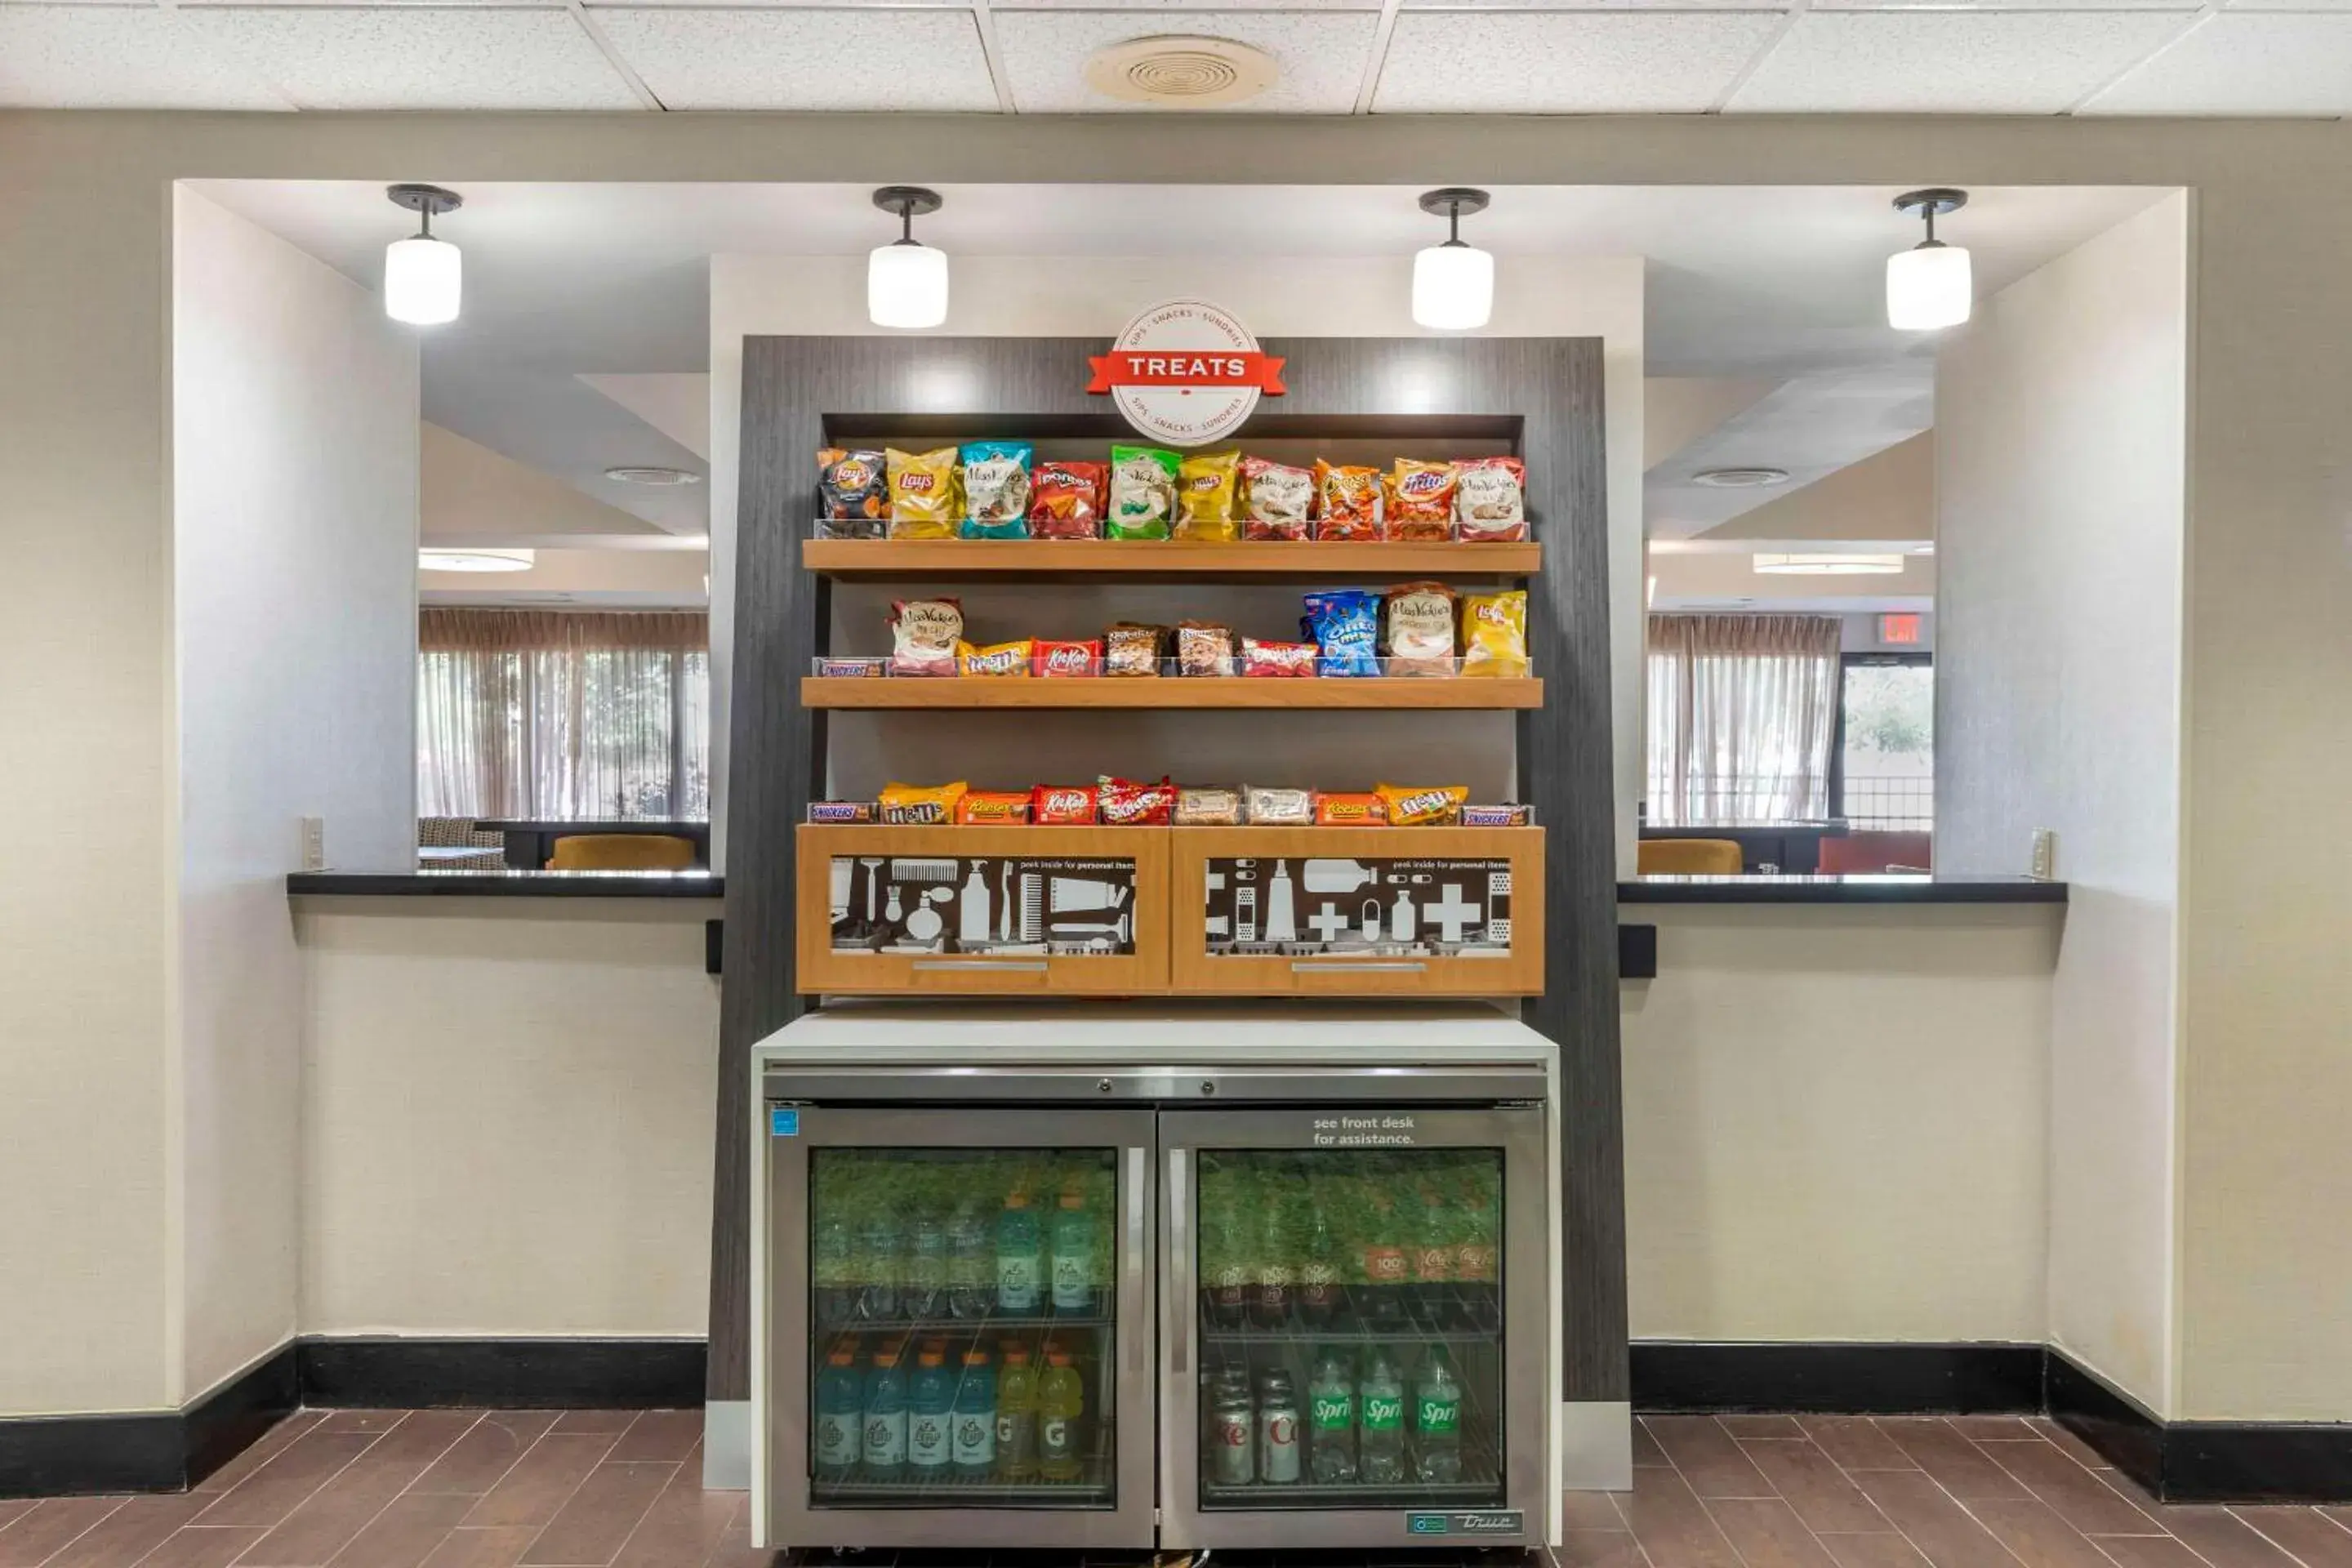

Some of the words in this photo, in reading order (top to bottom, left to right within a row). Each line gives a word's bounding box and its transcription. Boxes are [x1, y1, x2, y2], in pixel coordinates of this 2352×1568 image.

[1129, 327, 1147, 346] SIPS
[1152, 310, 1193, 325] SNACKS
[1202, 312, 1243, 348] SUNDRIES
[1127, 358, 1245, 376] TREATS
[1132, 397, 1148, 416] SIPS
[1153, 415, 1193, 433] SNACKS
[1201, 398, 1242, 430] SUNDRIES
[900, 473, 933, 490] Lay's
[1020, 861, 1039, 869] peek
[1040, 860, 1062, 869] inside
[1064, 860, 1075, 869] for
[1077, 862, 1114, 870] personal
[1393, 862, 1412, 870] peek
[1413, 861, 1435, 869] inside
[1437, 861, 1448, 869] for
[1450, 862, 1486, 870] personal
[1314, 1119, 1338, 1128] see
[1342, 1116, 1379, 1128] front
[1382, 1116, 1414, 1128] desk
[1314, 1133, 1334, 1144] for
[1339, 1133, 1414, 1145] assistance.
[1045, 1421, 1065, 1448] G
